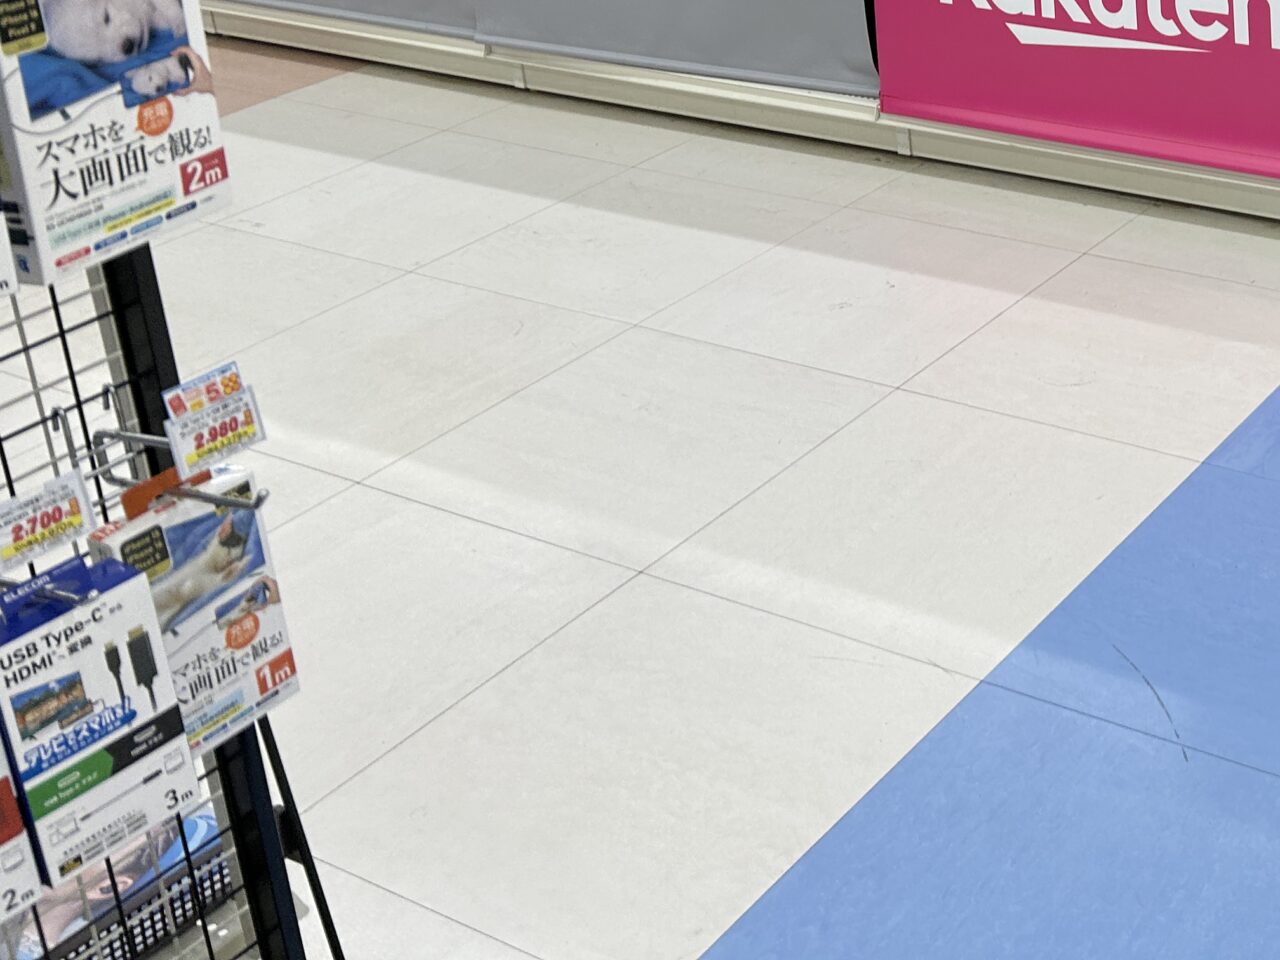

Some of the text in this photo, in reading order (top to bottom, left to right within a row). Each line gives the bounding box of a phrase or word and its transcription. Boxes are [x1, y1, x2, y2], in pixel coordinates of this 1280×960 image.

[36, 120, 125, 168] スマホを
[41, 126, 213, 211] 大画面で観る!
[187, 160, 223, 192] 2m
[194, 415, 239, 450] 2,980
[11, 505, 63, 544] 2,700
[0, 642, 39, 670] USB
[40, 607, 104, 648] Type-C
[172, 647, 220, 677] マホを
[260, 664, 292, 690] 1m
[164, 788, 193, 811] 3m
[2, 888, 35, 912] 2m
